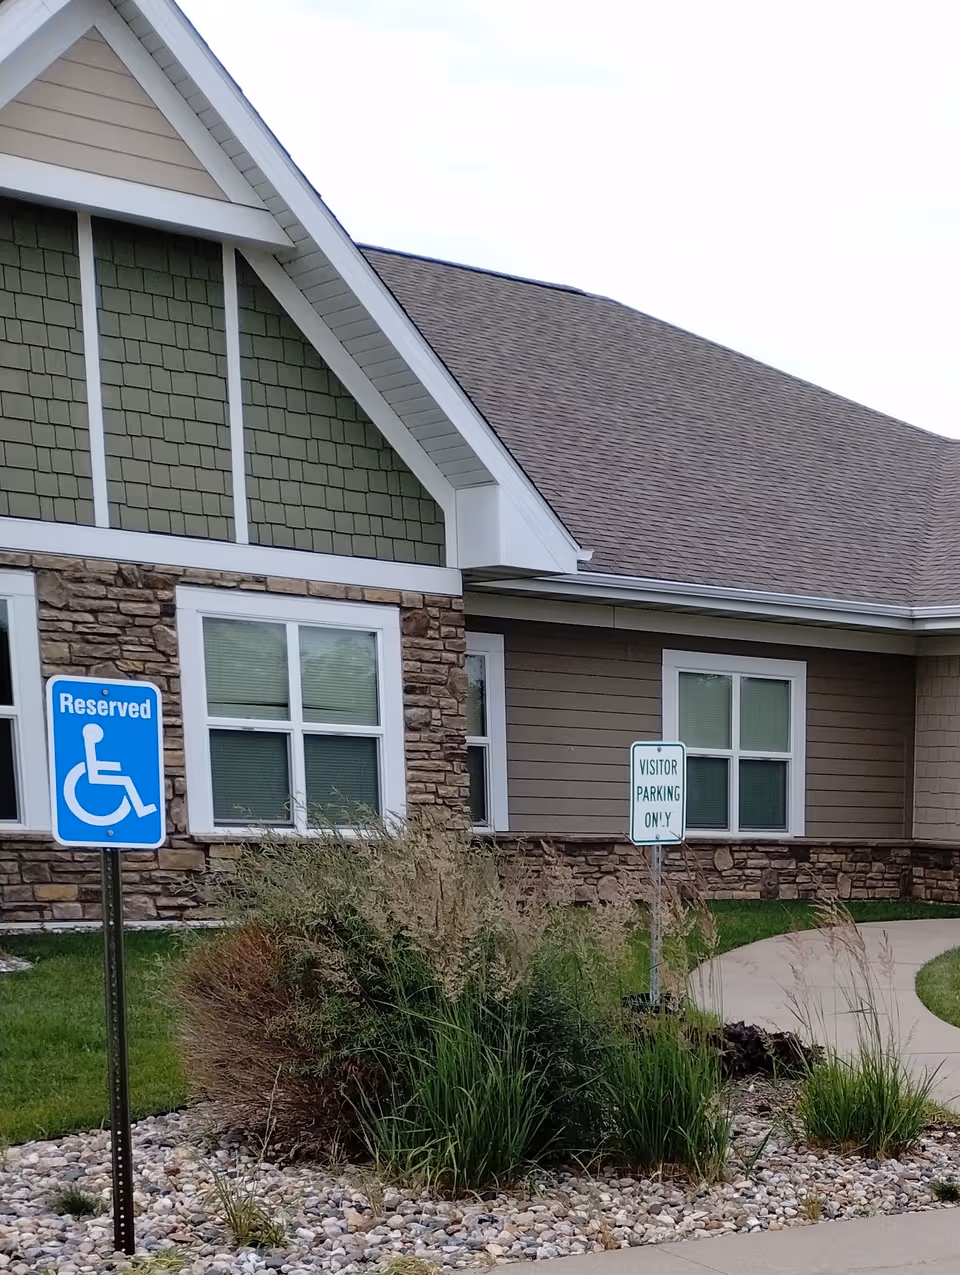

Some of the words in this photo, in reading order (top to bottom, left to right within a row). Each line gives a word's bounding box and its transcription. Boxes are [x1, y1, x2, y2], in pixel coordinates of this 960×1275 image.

[59, 692, 151, 719] Reserved
[639, 759, 678, 775] VISITOR
[637, 785, 681, 802] PARKING
